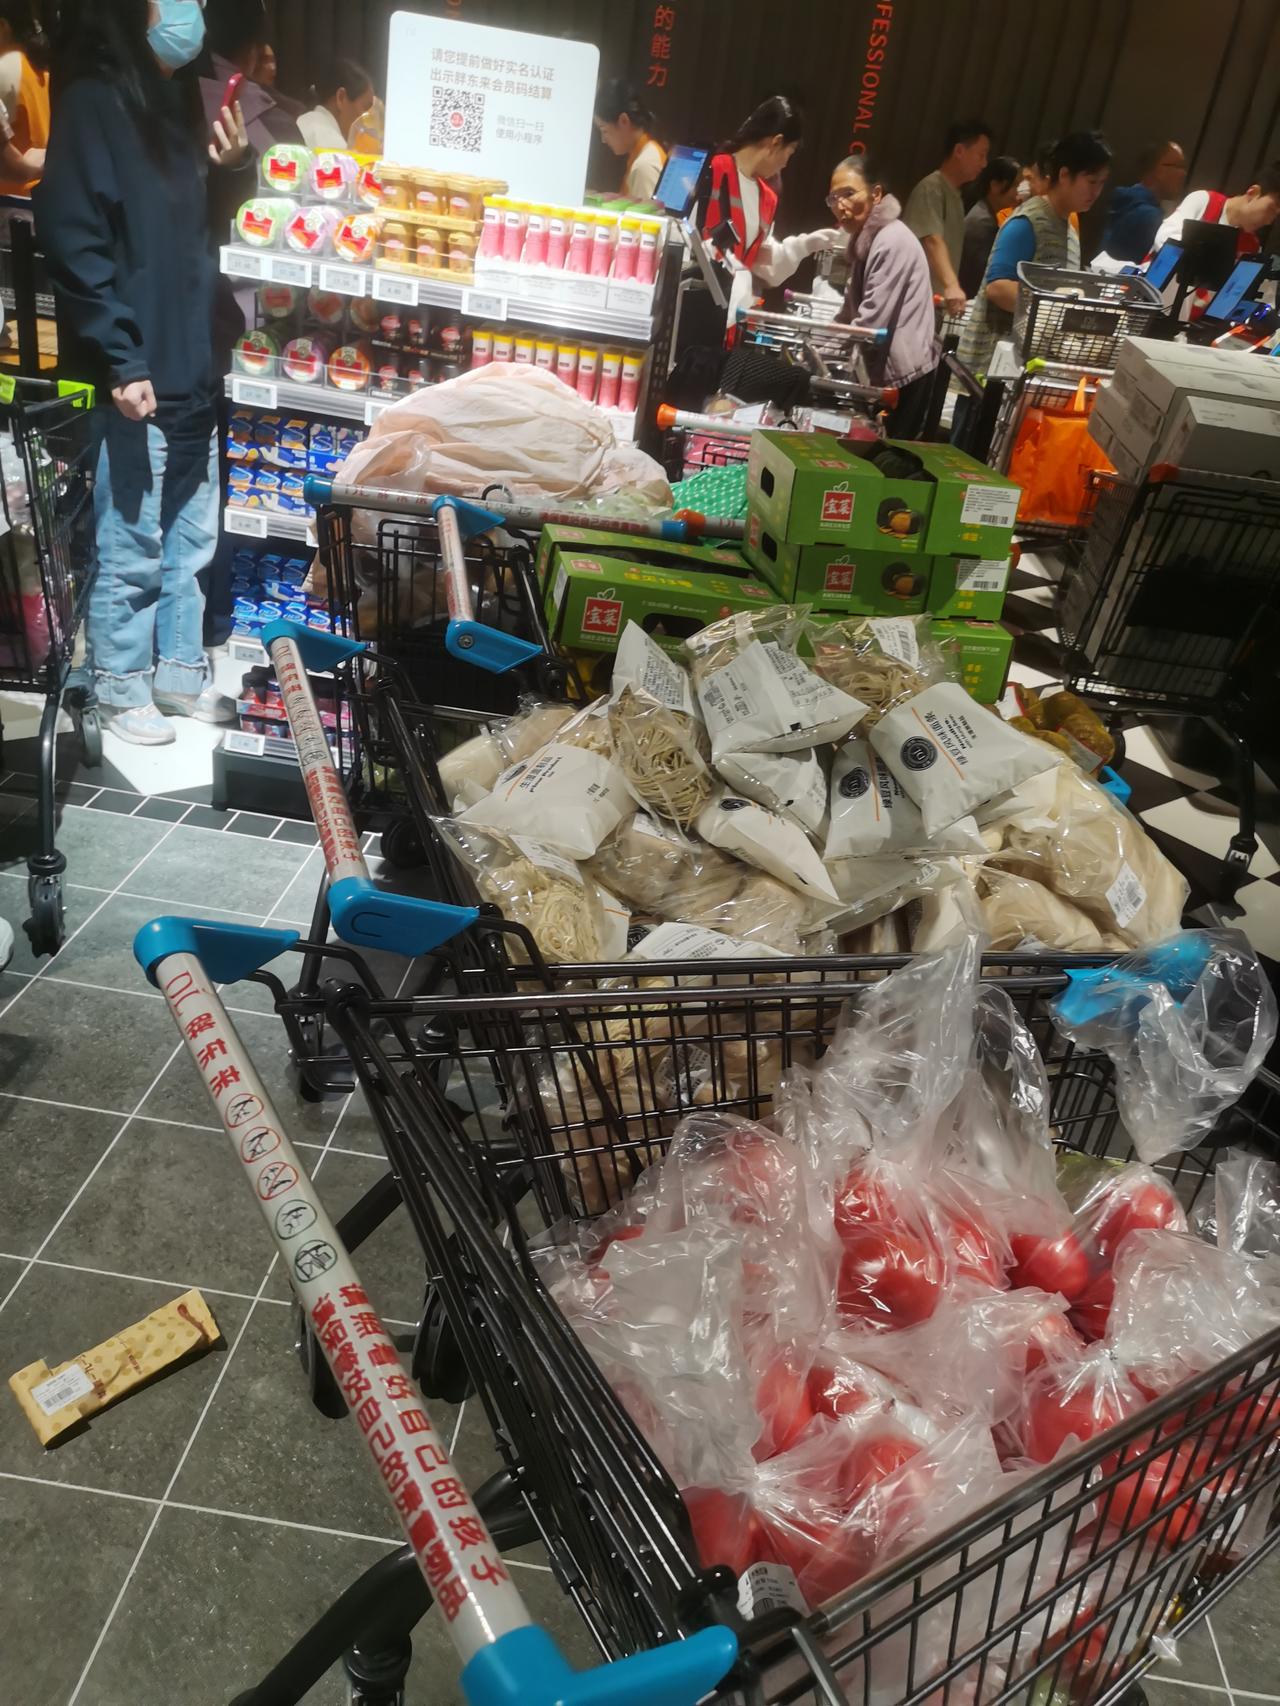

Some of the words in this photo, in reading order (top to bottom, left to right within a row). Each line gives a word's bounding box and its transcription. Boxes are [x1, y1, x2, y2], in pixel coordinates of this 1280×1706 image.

[431, 47, 556, 82] 请您提前做好实名认证
[646, 5, 675, 87] 的能力
[853, 0, 894, 134] FESSIONAL
[430, 67, 553, 101] 出示胖东来会员码结算
[495, 127, 544, 146] 使用小程序
[496, 114, 545, 132] 微信扫一扫
[311, 1291, 469, 1624] 请保管好自己的贵重物品
[338, 1282, 510, 1588] 请照看好自己的孩子
